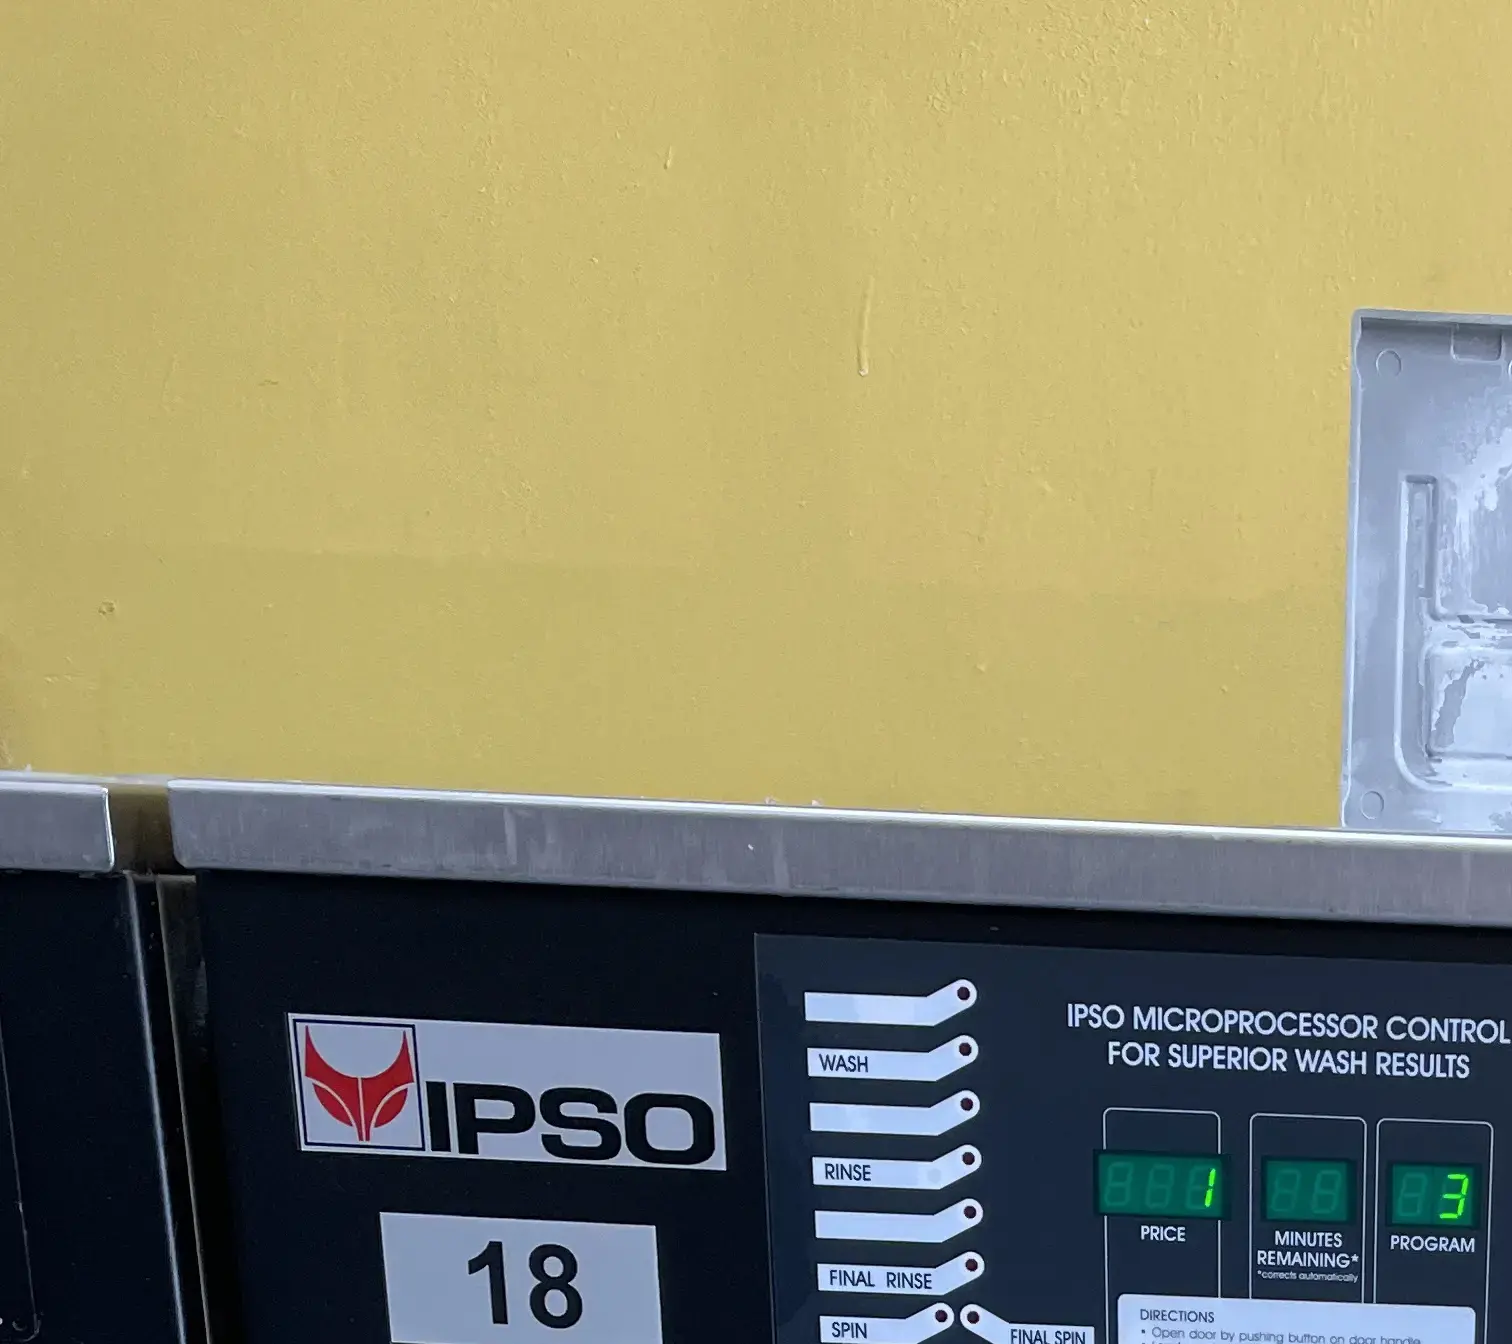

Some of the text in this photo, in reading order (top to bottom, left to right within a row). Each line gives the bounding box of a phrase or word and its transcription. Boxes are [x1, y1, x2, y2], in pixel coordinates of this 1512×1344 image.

[1066, 1003, 1512, 1045] IPSO MICROPROCESSOR CONTROL
[818, 1053, 869, 1073] WASH
[1107, 1041, 1471, 1079] FOR SUPERIOR WASH RESULTS
[424, 1079, 717, 1166] IPSO
[824, 1163, 872, 1182] RINSE
[1204, 1167, 1217, 1208] 1
[1438, 1172, 1469, 1219] 3
[1140, 1225, 1187, 1242] PRICE
[1274, 1229, 1343, 1248] MINUTES
[1389, 1234, 1476, 1254] PROGRAM
[466, 1240, 584, 1330] 18
[829, 1270, 932, 1290] FINAL RINSE
[1298, 1271, 1359, 1284] automatically
[1139, 1308, 1216, 1324] DIRECTIONS
[831, 1322, 868, 1340] SPIN
[1151, 1326, 1185, 1340] Open
[1188, 1328, 1217, 1341] door
[1220, 1329, 1235, 1343] by
[1288, 1332, 1326, 1344] button
